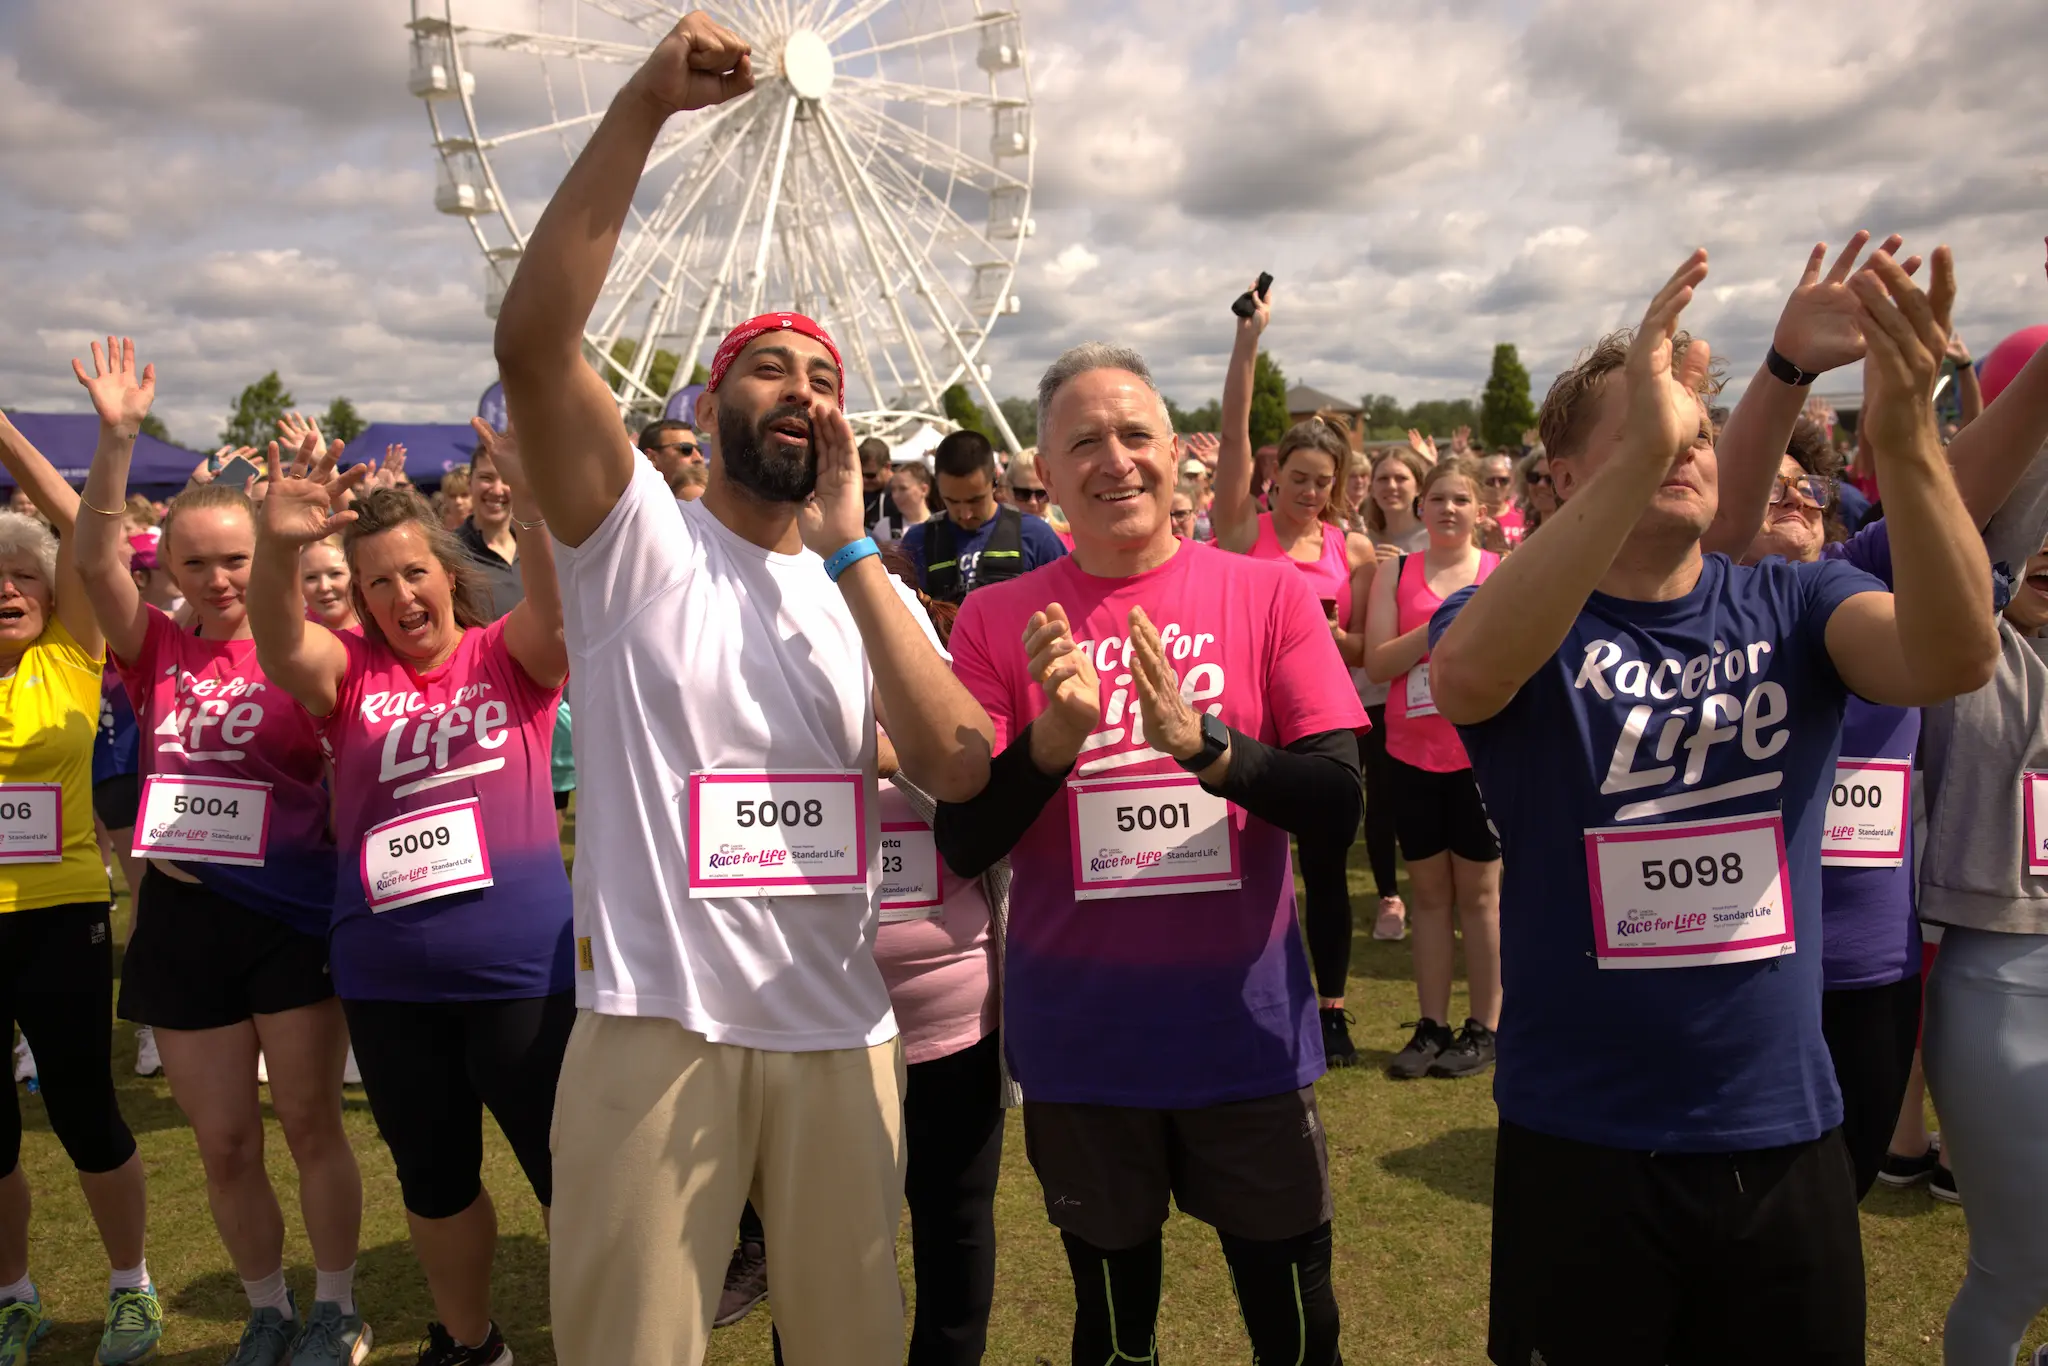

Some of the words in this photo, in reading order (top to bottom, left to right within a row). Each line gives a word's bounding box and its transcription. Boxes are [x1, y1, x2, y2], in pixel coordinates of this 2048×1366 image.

[1075, 636, 1135, 672] ace
[1160, 623, 1215, 660] for
[1574, 638, 1710, 701] Race
[1707, 639, 1772, 691] for
[217, 676, 266, 698] for
[451, 681, 492, 707] for
[378, 700, 509, 784] Life
[1599, 680, 1791, 796] Life
[0, 802, 32, 820] 06
[173, 795, 239, 818] 5004
[736, 799, 823, 828] 5008
[1116, 802, 1190, 832] 5001
[149, 828, 174, 839] Race
[186, 829, 209, 839] Life
[211, 832, 239, 840] Standard
[388, 826, 450, 858] 5009
[1831, 826, 1855, 838] Life
[1858, 828, 1884, 836] Standard
[431, 860, 460, 872] Standard
[460, 858, 472, 866] Life
[709, 852, 741, 869] Race
[742, 852, 759, 865] for
[758, 849, 787, 865] Life
[791, 849, 829, 859] Standard
[829, 849, 845, 858] Life
[1090, 856, 1118, 872] Race
[1119, 855, 1137, 868] for
[1136, 850, 1162, 866] Life
[1166, 849, 1203, 860] Standard
[1203, 848, 1218, 857] Life
[376, 876, 397, 891] Race
[397, 873, 410, 884] for
[409, 866, 428, 880] Life
[1641, 852, 1744, 891] 5098
[1616, 919, 1652, 937] Race
[1654, 919, 1674, 931] for
[1674, 912, 1707, 930] Life
[1713, 907, 1754, 922] Standard
[1755, 906, 1772, 918] Life
